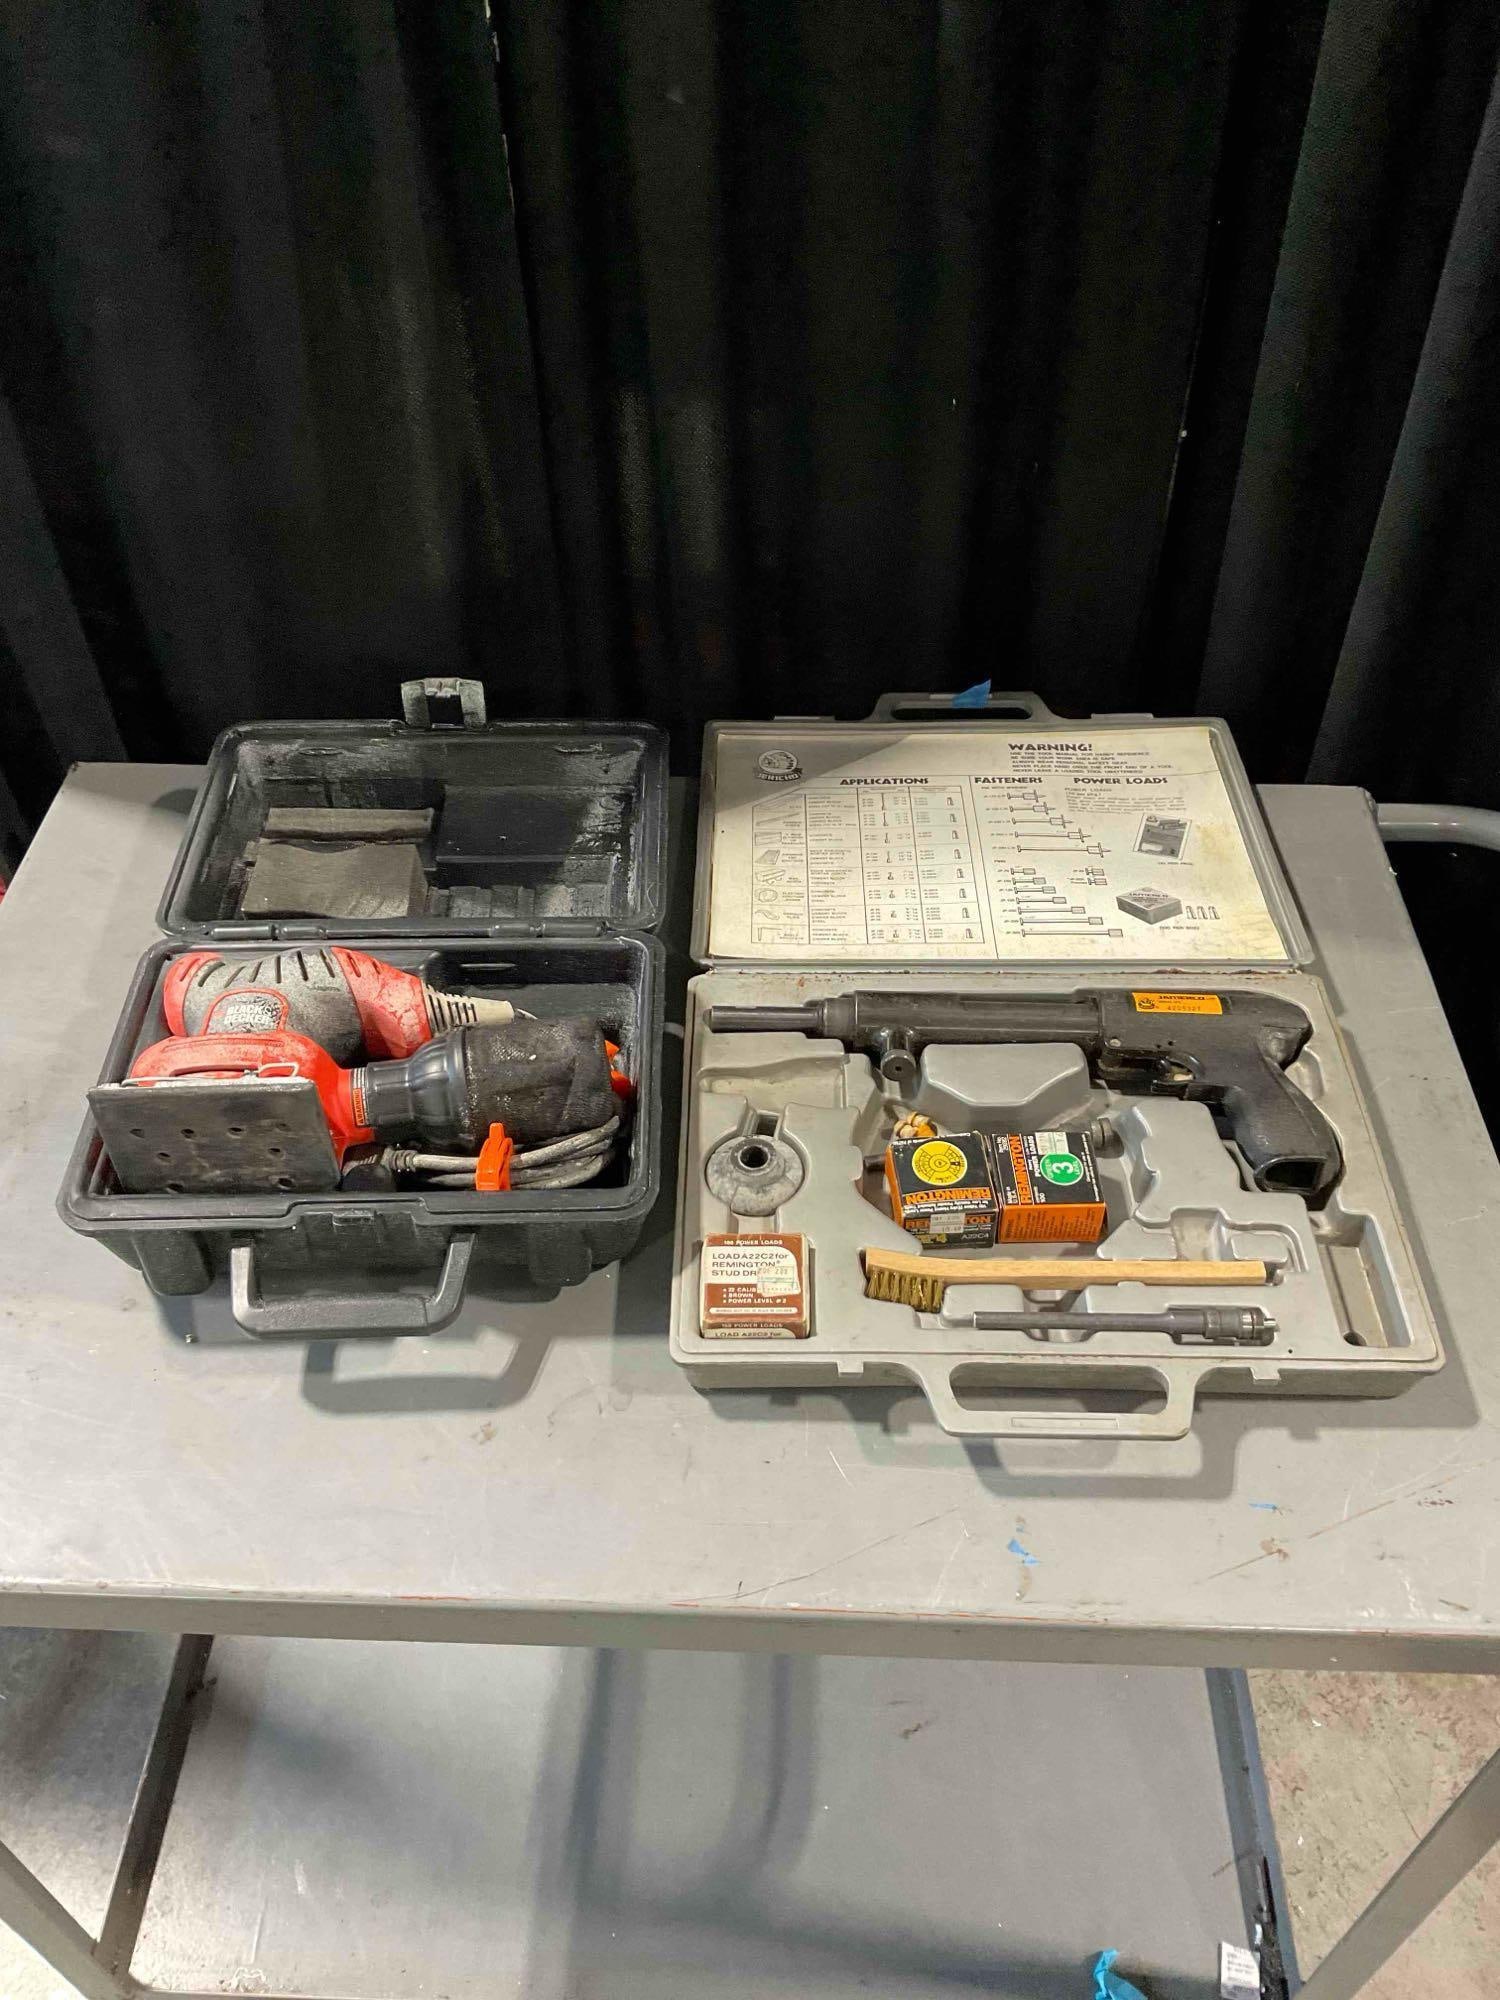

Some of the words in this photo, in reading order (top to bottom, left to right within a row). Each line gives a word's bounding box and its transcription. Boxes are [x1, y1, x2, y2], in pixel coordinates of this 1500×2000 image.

[1008, 743, 1093, 752] WARNING!
[757, 772, 799, 782] JERICHO
[840, 778, 929, 786] APPLICATIONS
[974, 776, 1042, 784] FASTENERS
[227, 1004, 262, 1014] BLACK
[224, 1013, 272, 1024] DECKER
[354, 1090, 364, 1119] WARNING
[1028, 1136, 1036, 1154] LOADS
[1008, 1133, 1032, 1204] REMINGTON
[1032, 1156, 1041, 1177] POWER
[1052, 1162, 1073, 1174] 3
[906, 1188, 991, 1204] REMINGTON
[906, 1216, 991, 1229] RETON
